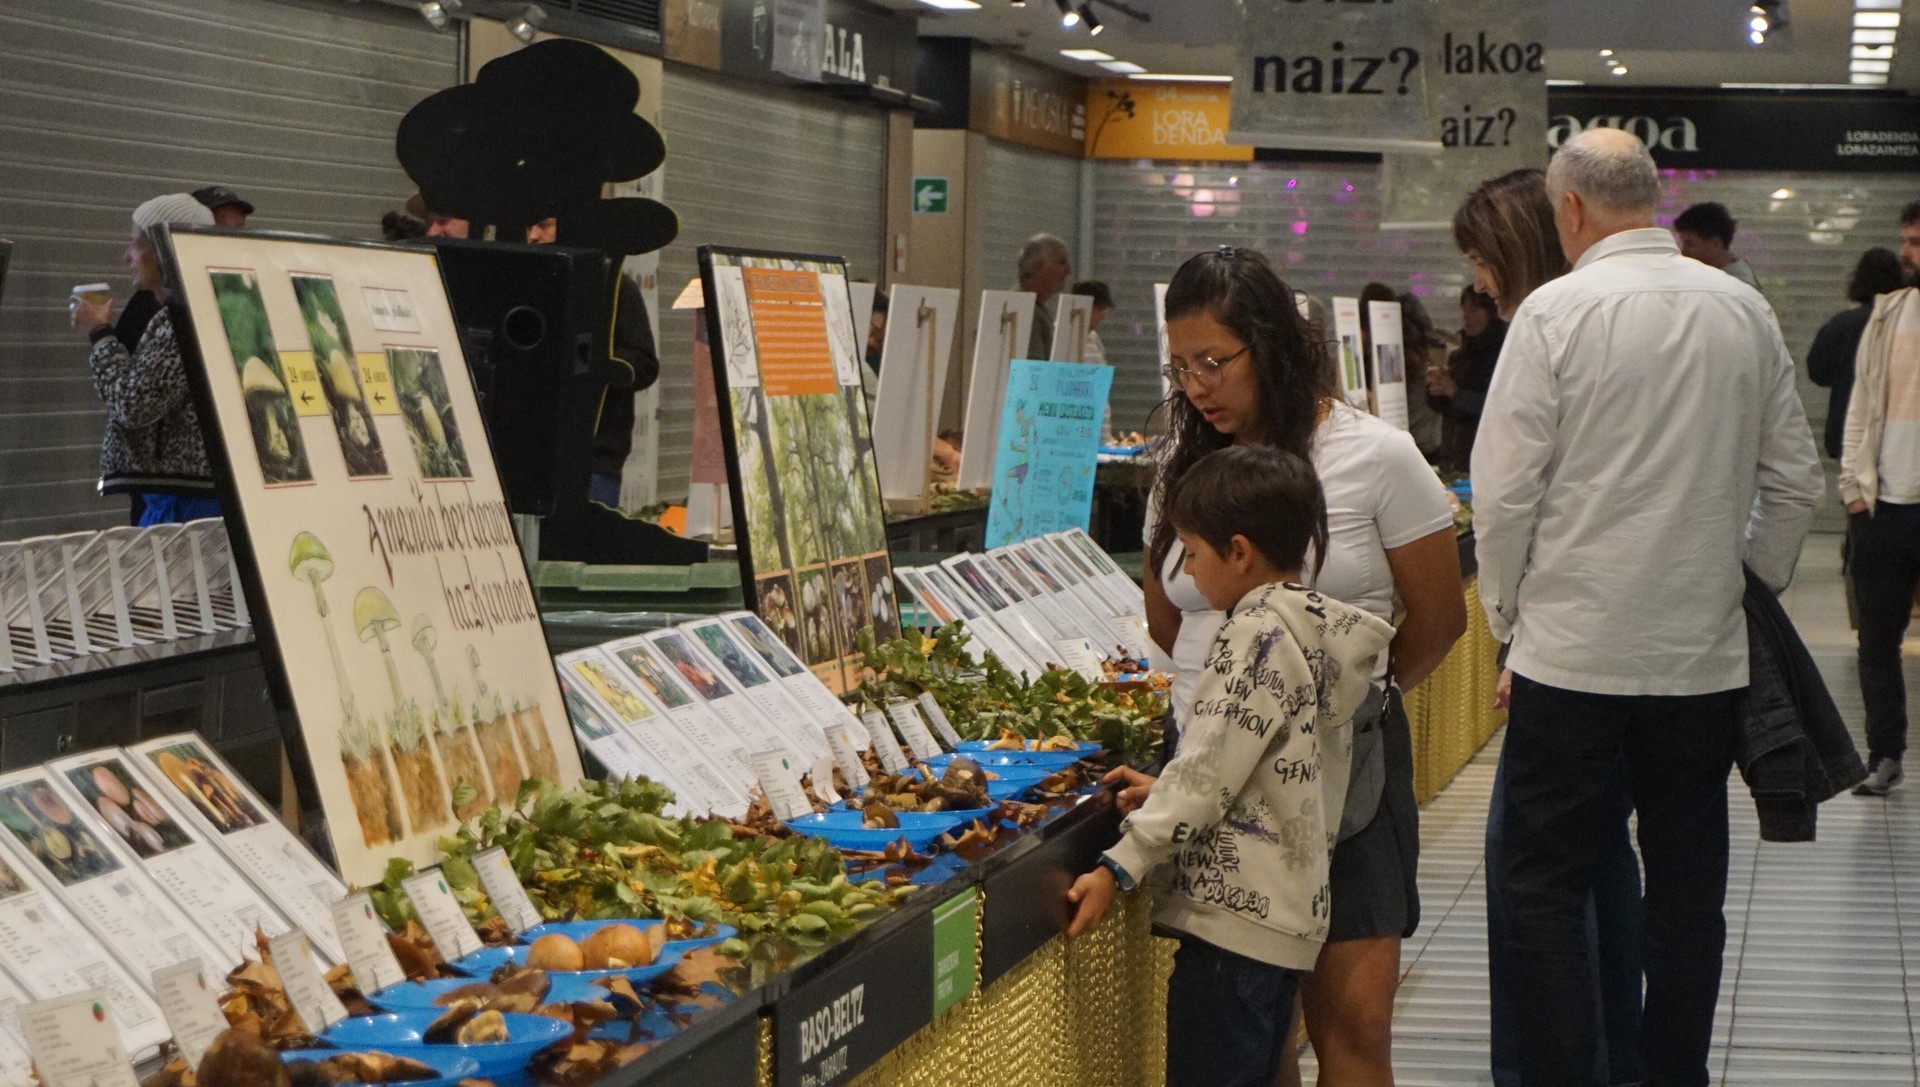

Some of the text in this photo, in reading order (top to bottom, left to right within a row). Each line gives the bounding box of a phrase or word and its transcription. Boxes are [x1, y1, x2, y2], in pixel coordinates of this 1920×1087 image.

[1253, 41, 1420, 95] naiz?
[1444, 32, 1544, 75] lakoa
[1153, 109, 1209, 129] LORA
[1153, 126, 1227, 145] DENDA
[1546, 113, 1699, 152] aoa
[1194, 698, 1274, 739] GENERATION
[801, 983, 865, 1064] BASO-BELTZ
